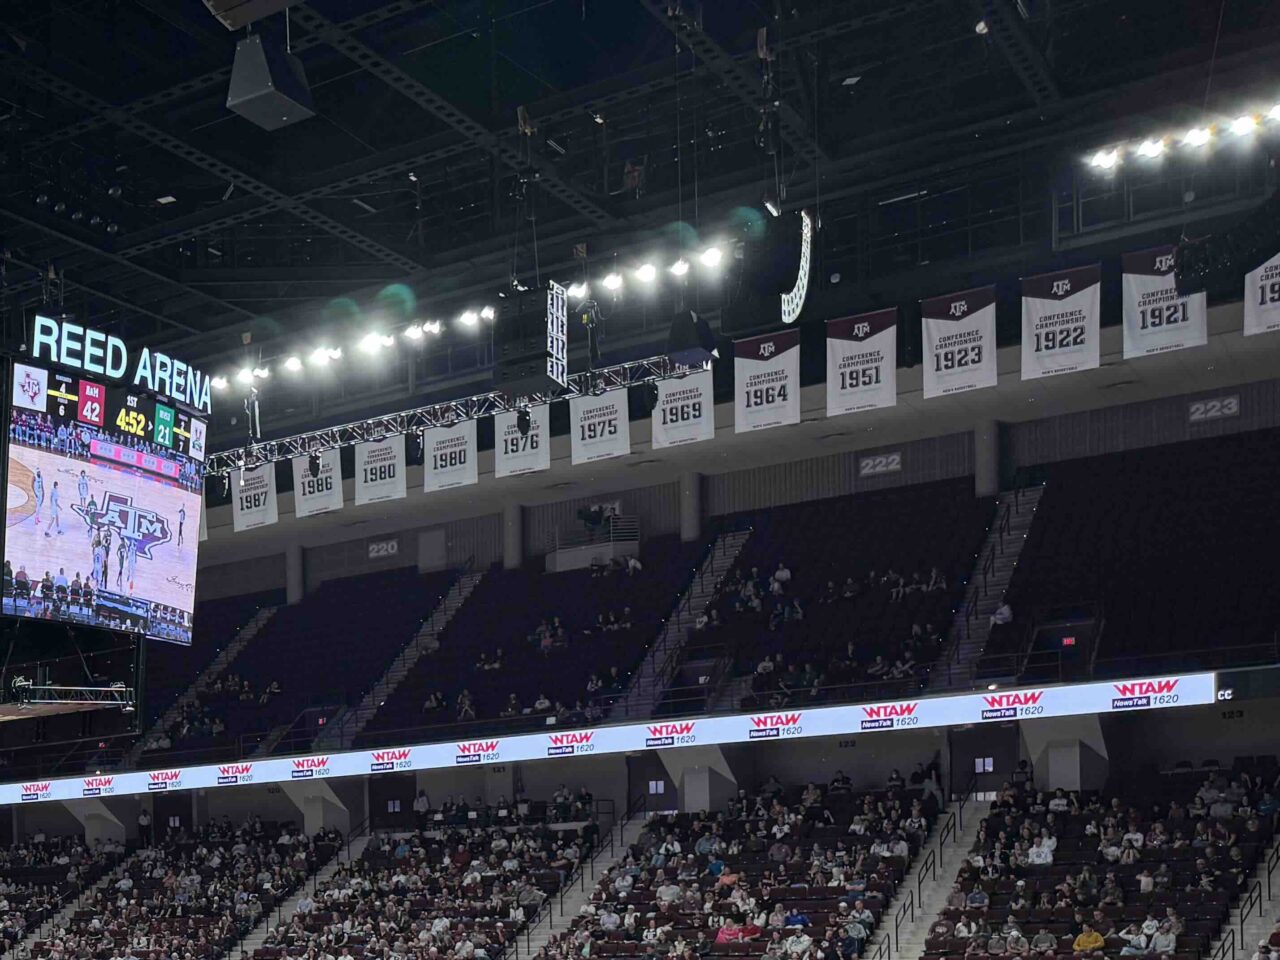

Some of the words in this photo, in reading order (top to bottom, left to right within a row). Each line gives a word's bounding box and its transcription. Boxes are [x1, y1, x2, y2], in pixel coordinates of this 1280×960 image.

[1034, 315, 1087, 329] CHAMPIONSHIP
[1039, 309, 1083, 322] CONFERENCE
[1138, 301, 1189, 330] 1921
[935, 335, 984, 351] CHAMPIONSHIP
[938, 329, 980, 343] CONFERENCE
[1033, 325, 1086, 352] 1922
[838, 356, 884, 369] CHAMPIONSHIP
[842, 350, 881, 362] CONFERENCE
[933, 345, 983, 372] 1923
[32, 315, 128, 379] REED
[133, 346, 212, 415] ARENA
[745, 375, 789, 388] CHAMPIONSHIP
[749, 369, 785, 380] CONFERENCE
[839, 365, 882, 390] 1951
[662, 392, 703, 405] CHAMPIONSHIP
[665, 387, 699, 399] CONFERENCE
[745, 383, 788, 408] 1964
[126, 395, 138, 408] 1ST
[58, 404, 65, 416] 6
[82, 400, 101, 422] 42
[580, 409, 618, 422] CHAMPIONSHIP
[582, 404, 615, 416] CONFERENCE
[661, 401, 702, 425] 1969
[1189, 398, 1237, 420] 223
[115, 407, 146, 436] 4:52
[157, 424, 170, 445] 21
[579, 418, 618, 441] 1975
[435, 435, 465, 447] CONFERENCE
[503, 433, 539, 455] 1976
[432, 449, 467, 471] 1980
[862, 455, 901, 475] 222
[362, 463, 396, 484] 1980
[300, 475, 333, 497] 1986
[239, 491, 268, 512] 1987
[368, 541, 398, 558] 220
[1113, 679, 1180, 697] WTAW
[981, 691, 1044, 708] WTAW
[1114, 697, 1149, 708] NewsTalk
[1153, 694, 1180, 705] 1620
[862, 702, 919, 719] WTAW
[982, 709, 1017, 718] NewsTalk
[1019, 705, 1044, 717] 1620
[750, 712, 803, 729] WTAW
[896, 716, 919, 726] 1620
[647, 722, 696, 737] WTAW
[781, 726, 803, 736] 1620
[548, 731, 594, 746] WTAW
[676, 734, 697, 744] 1620
[457, 740, 500, 754] WTAW
[576, 743, 595, 753] 1620
[371, 749, 411, 762] WTAW
[482, 752, 500, 761] 1620
[217, 763, 253, 775] WTAW
[292, 757, 329, 769] WTAW
[394, 760, 412, 769] 1620
